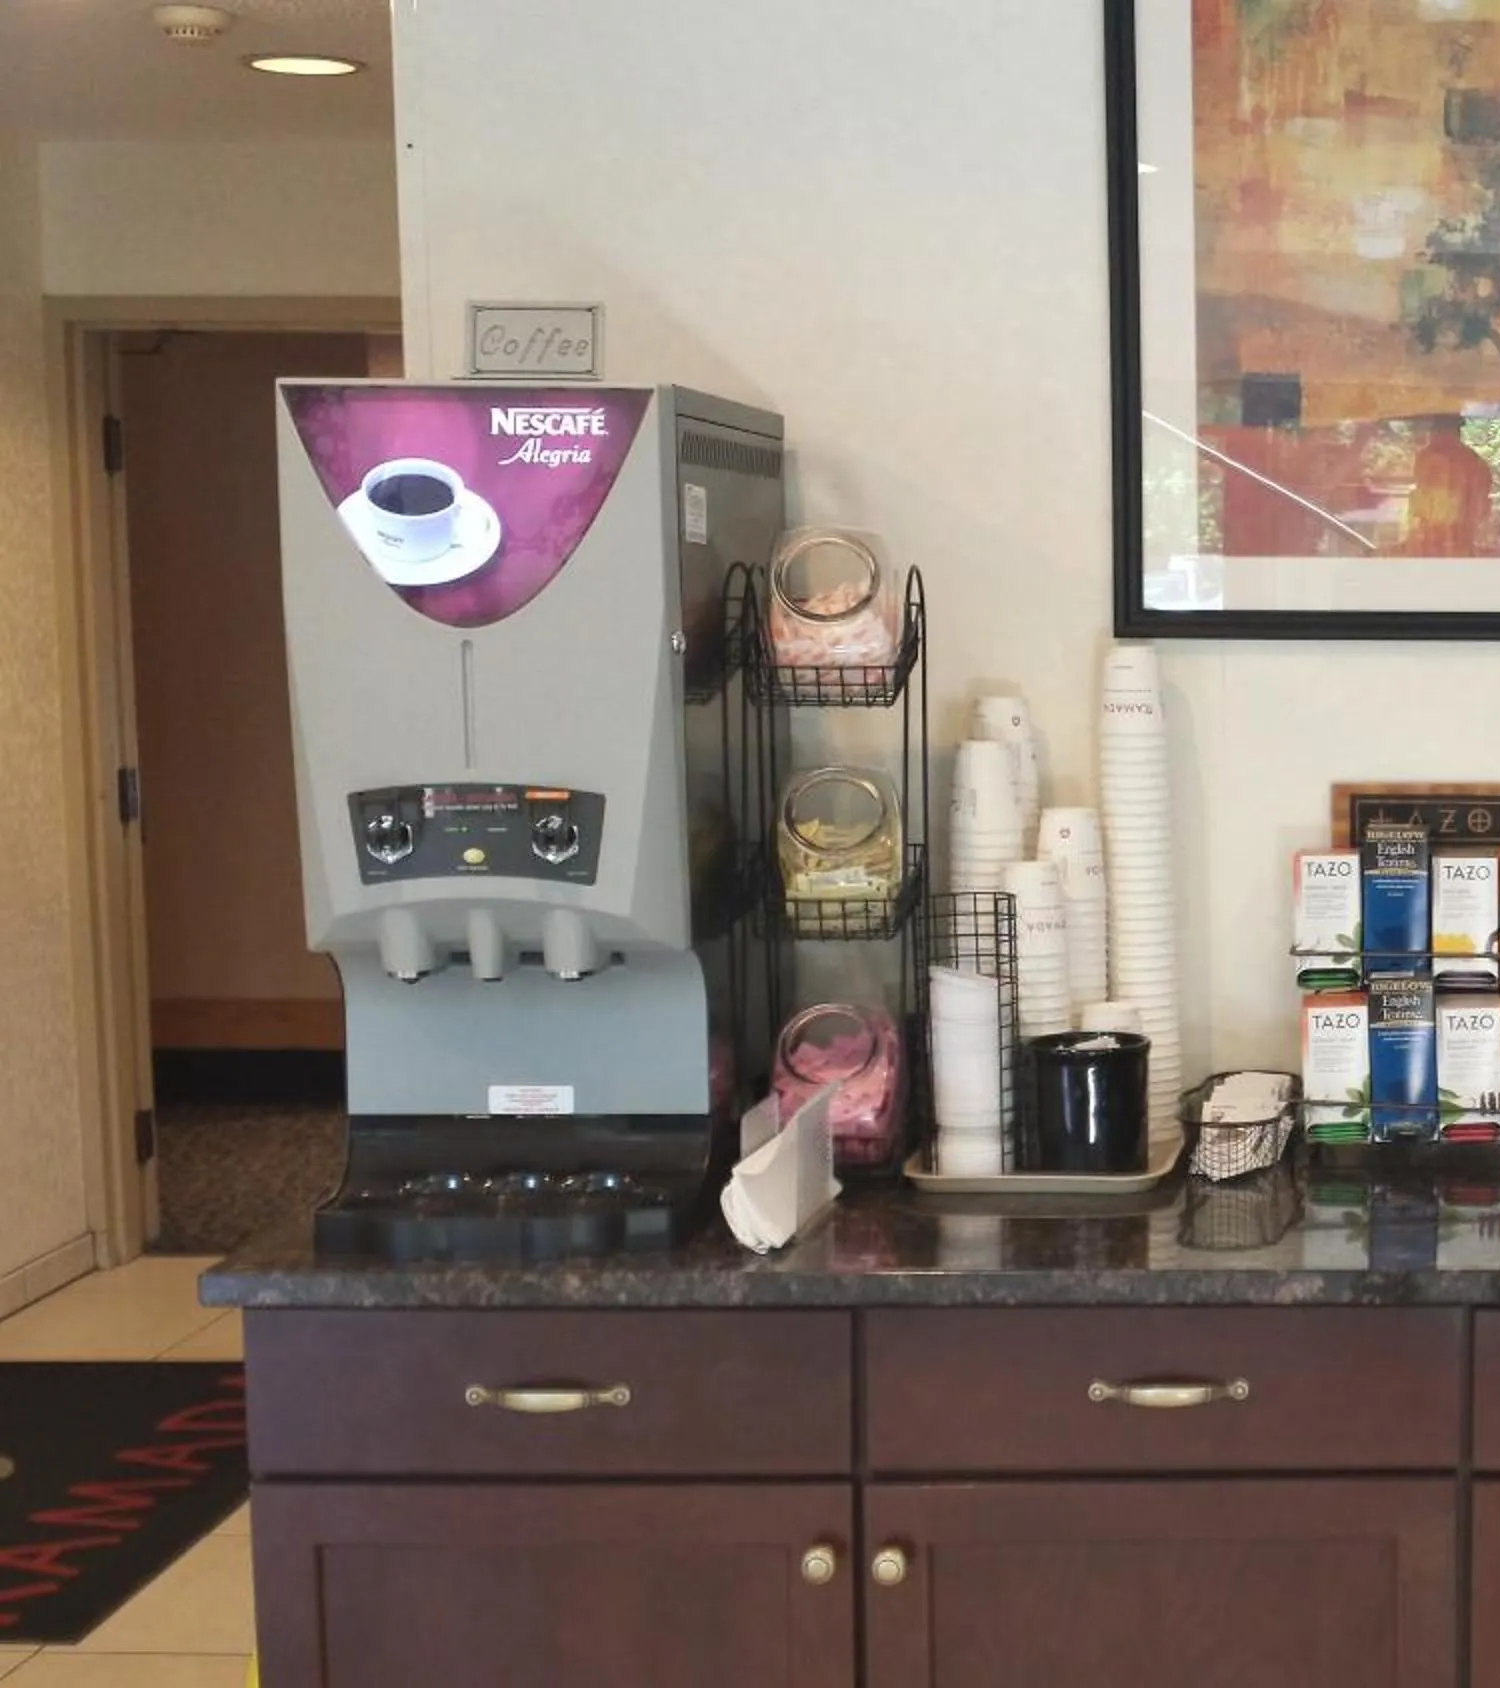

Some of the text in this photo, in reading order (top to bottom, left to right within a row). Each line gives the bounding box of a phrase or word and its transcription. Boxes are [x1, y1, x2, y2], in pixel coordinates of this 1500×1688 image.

[480, 324, 590, 364] Coffee
[490, 407, 608, 435] NESCAFÉ
[498, 438, 592, 467] Alegria
[1376, 842, 1416, 856] English
[1305, 861, 1352, 877] TAZO
[1442, 865, 1491, 881] TAZO
[1382, 995, 1422, 1008] English
[1312, 1013, 1361, 1030] TAZO
[1446, 1014, 1495, 1031] TAZO
[0, 1374, 247, 1627] AMAD
